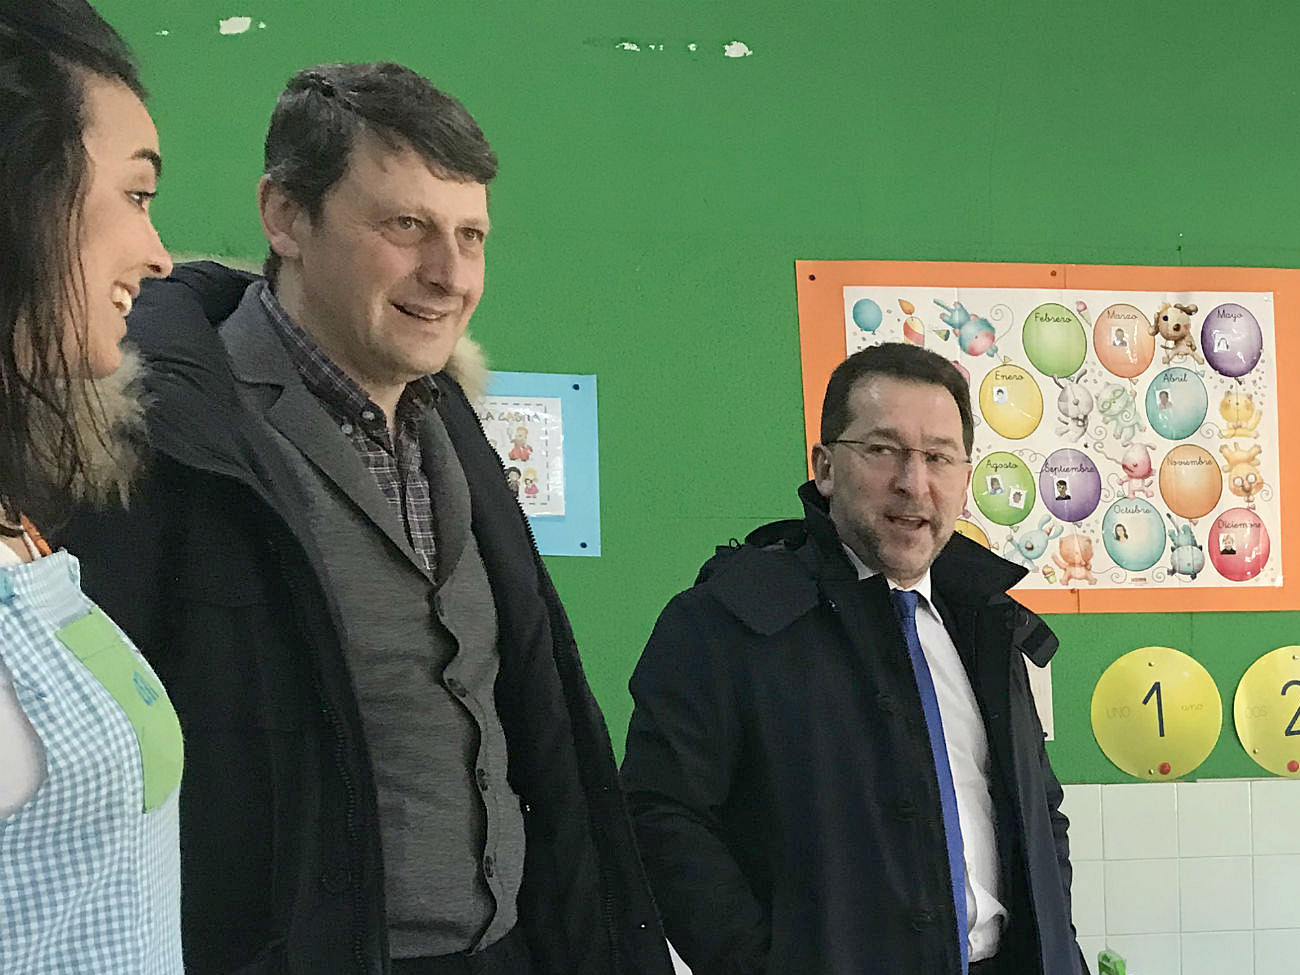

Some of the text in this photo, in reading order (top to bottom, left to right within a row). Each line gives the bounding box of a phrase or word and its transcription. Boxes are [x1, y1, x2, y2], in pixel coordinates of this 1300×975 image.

[1033, 312, 1073, 324] Febrero
[1106, 311, 1138, 320] Marzo
[1216, 311, 1244, 321] Mayo
[994, 372, 1024, 381] Enero
[1163, 372, 1188, 383] Abril
[986, 459, 1018, 472] Agosto
[1166, 457, 1213, 467] Noviembre
[1043, 462, 1096, 474] Septiembre
[1113, 504, 1151, 514] Octubre
[1217, 519, 1261, 529] Diciembre
[1142, 681, 1165, 737] 1
